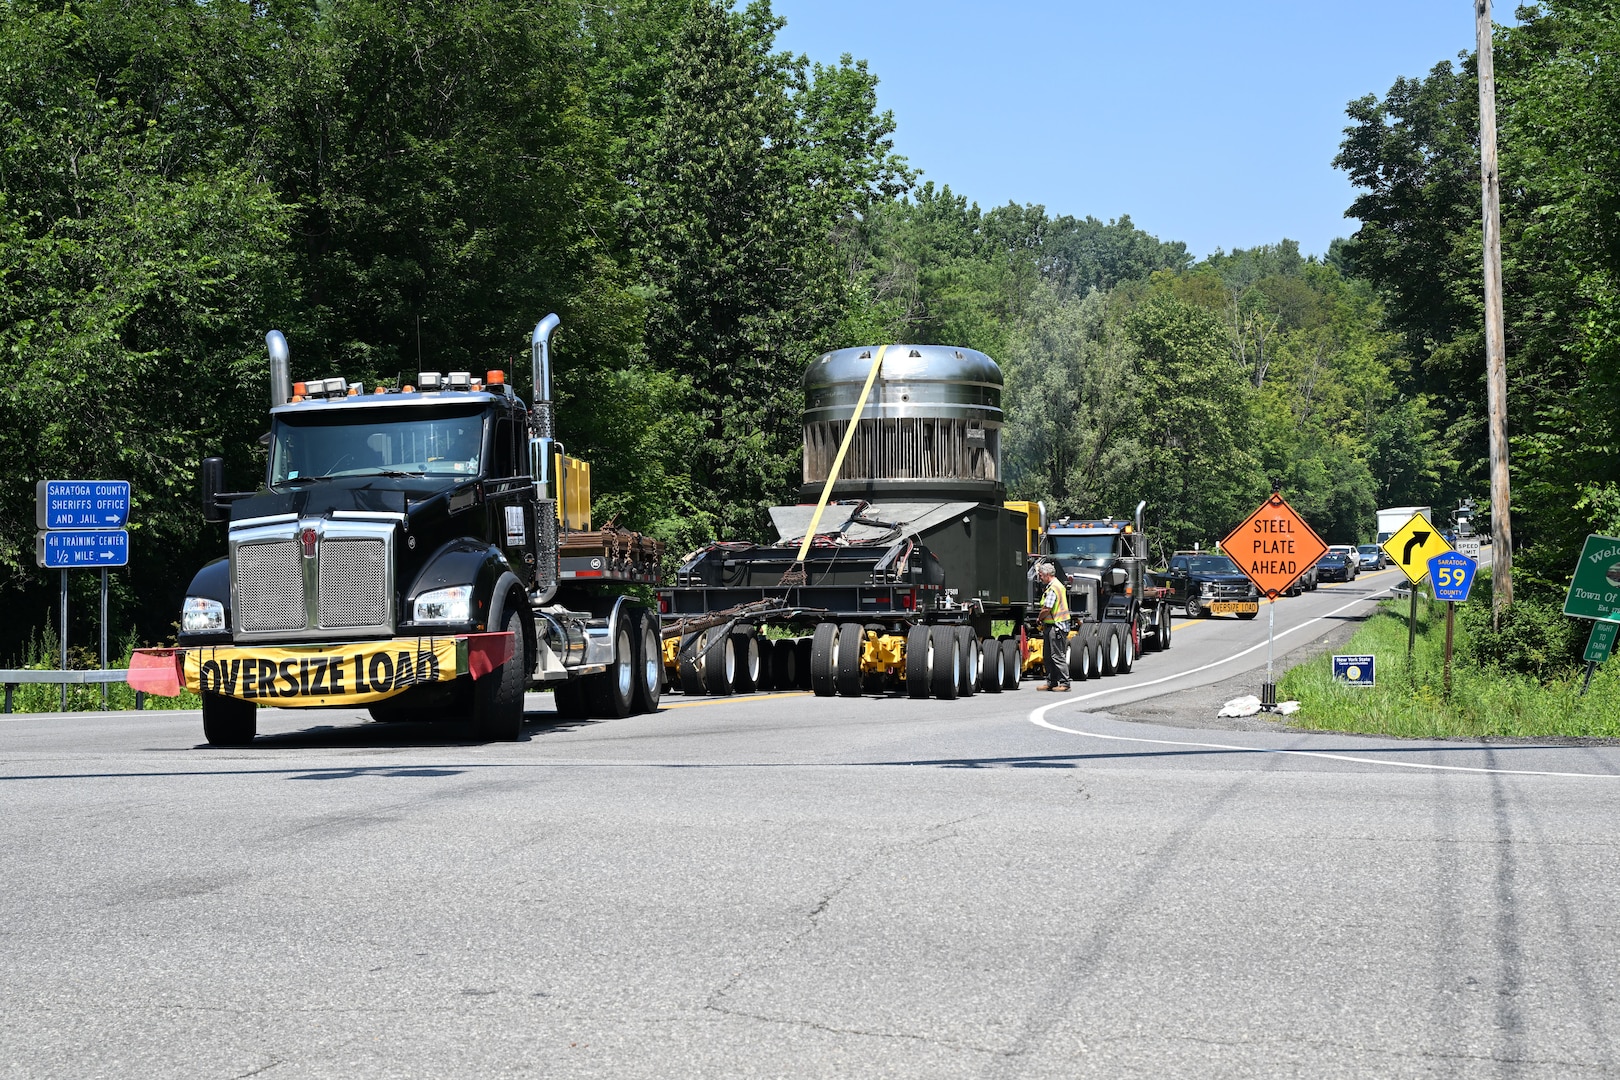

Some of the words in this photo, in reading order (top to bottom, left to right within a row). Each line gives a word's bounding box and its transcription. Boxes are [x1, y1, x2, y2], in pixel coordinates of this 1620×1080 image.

[49, 486, 91, 496] SARATOGA
[96, 486, 127, 496] COUNTY
[52, 500, 92, 510] SHERIFFS
[97, 500, 125, 510] OFFICE
[56, 514, 74, 524] AND
[80, 514, 97, 524] JAIL
[1254, 519, 1295, 534] STEEL
[49, 536, 59, 547] 4H
[63, 537, 96, 546] TRAINING
[99, 536, 125, 546] CENTER
[1253, 540, 1295, 554] PLATE
[74, 551, 94, 562] MILE
[1251, 560, 1297, 574] AHEAD
[1438, 567, 1466, 587] 59
[1575, 588, 1601, 601] Town
[1604, 592, 1618, 603] Of
[1212, 603, 1240, 612] OVERSIZE
[1241, 603, 1256, 612] LOAD
[1599, 633, 1607, 641] TO
[200, 656, 345, 698] OVERSIZE
[355, 651, 440, 693] LOAD
